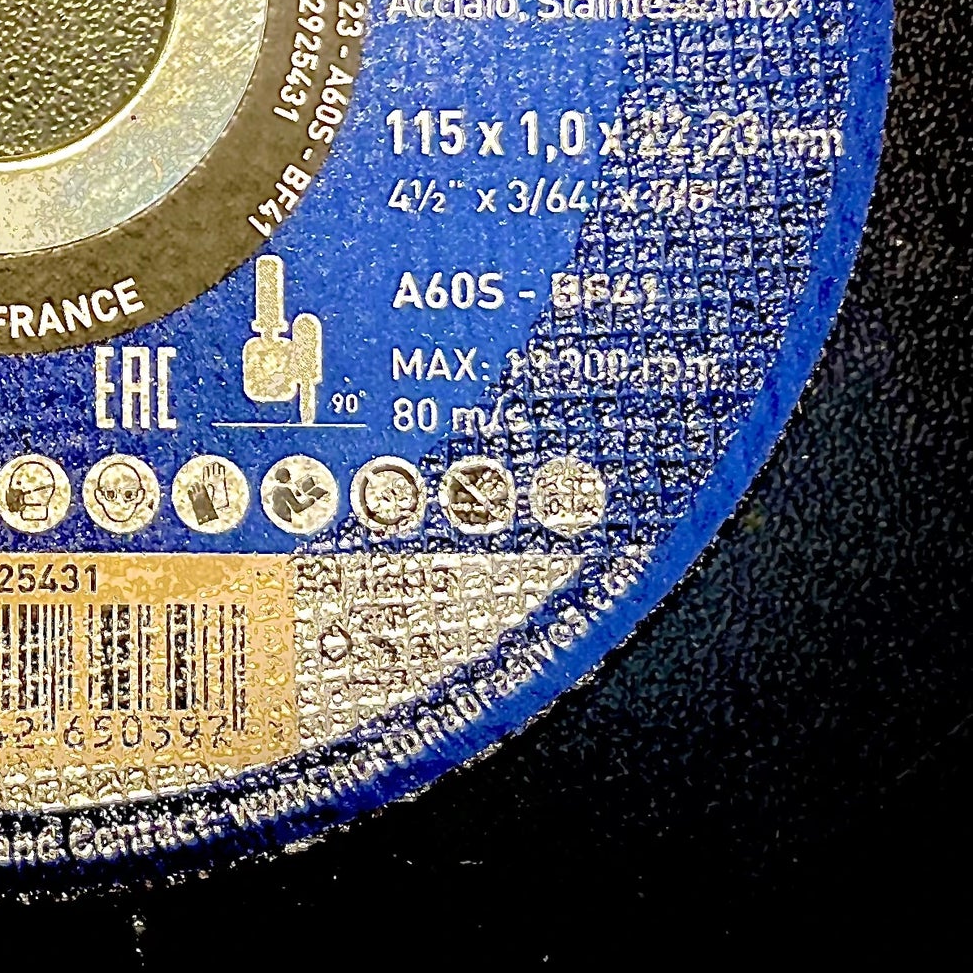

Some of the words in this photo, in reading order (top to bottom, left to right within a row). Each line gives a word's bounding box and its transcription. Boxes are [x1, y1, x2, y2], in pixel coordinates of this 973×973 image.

[307, 64, 354, 145] A60S
[385, 110, 465, 157] 115
[478, 119, 504, 156] x
[519, 110, 587, 162] 1,0
[247, 164, 312, 238] BF41
[391, 272, 504, 310] A60S
[391, 348, 491, 381] MAX:
[392, 398, 439, 431] 80
[450, 396, 530, 437] m/s
